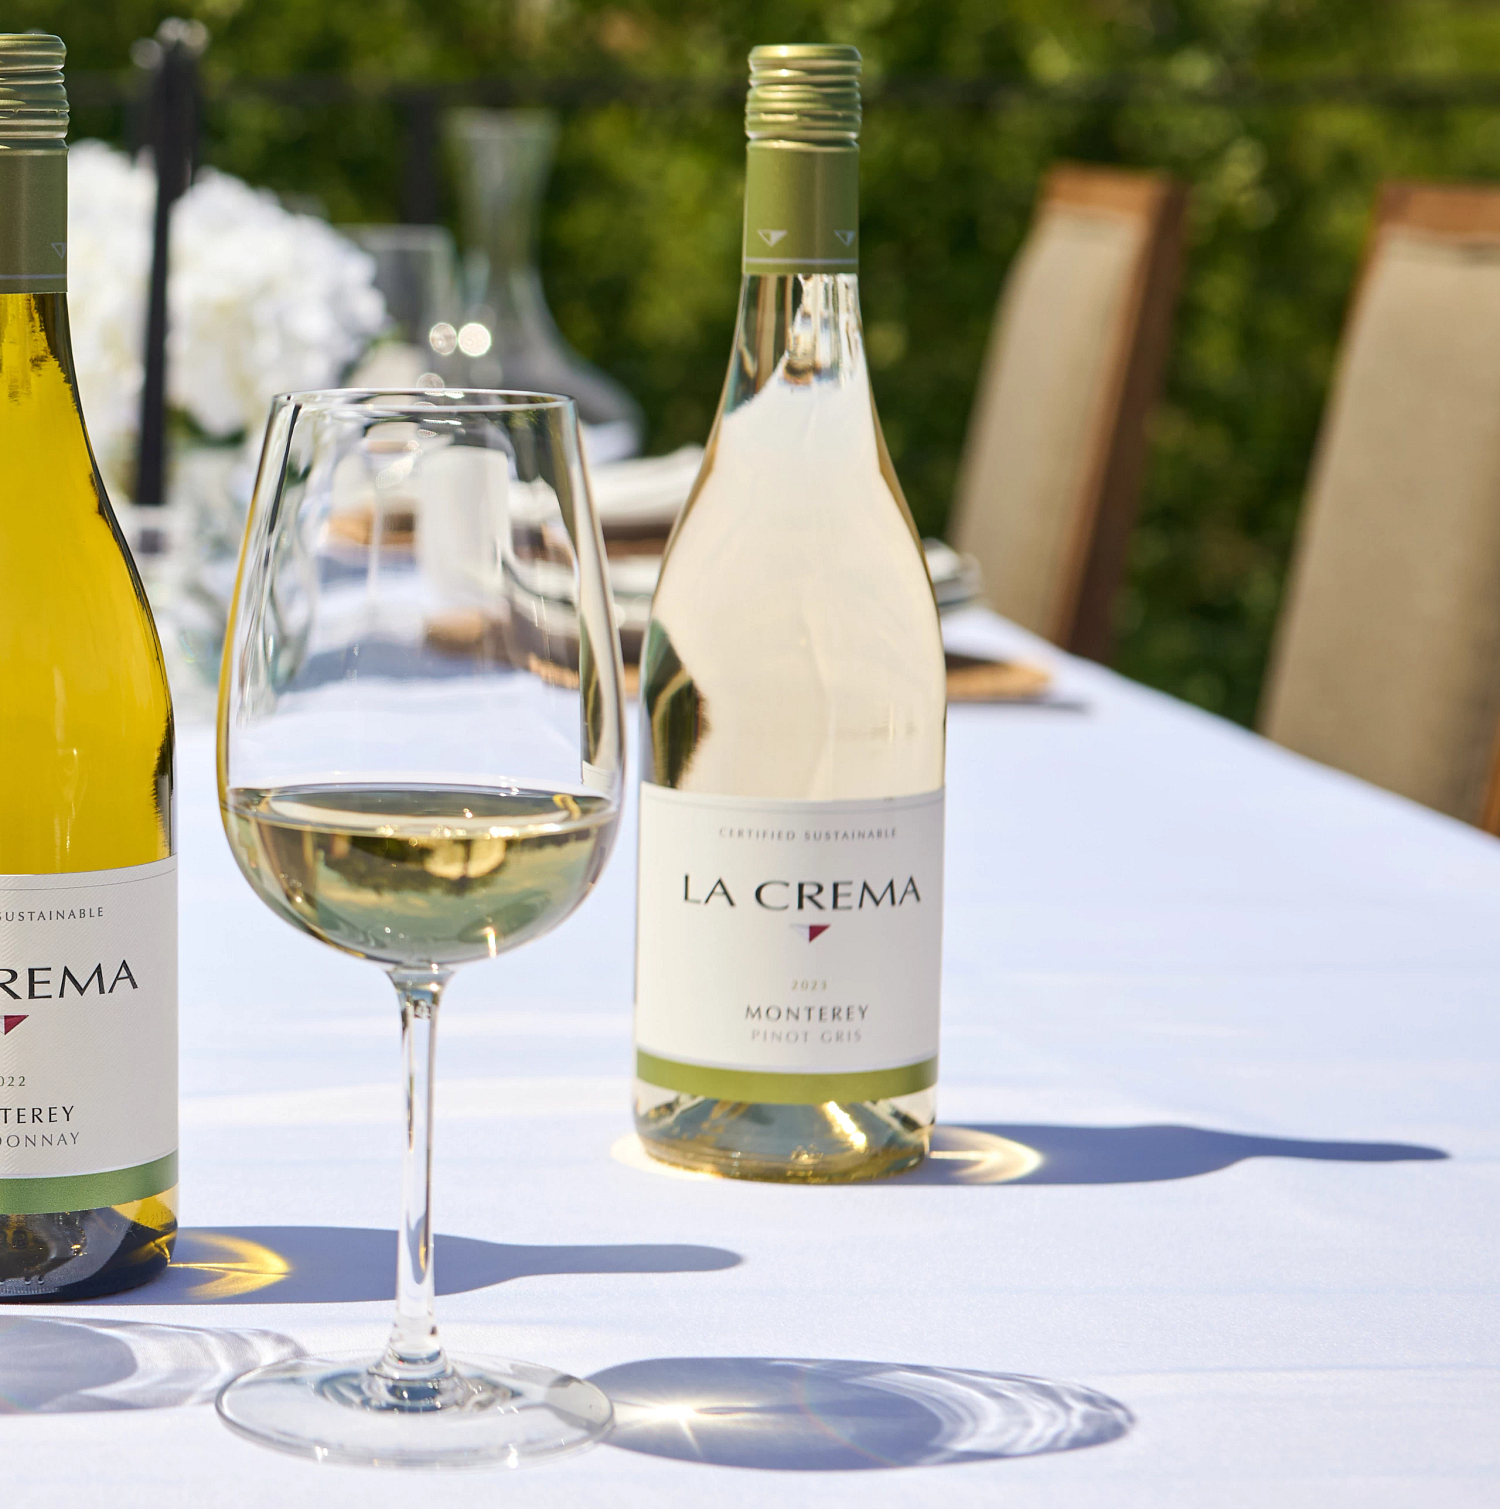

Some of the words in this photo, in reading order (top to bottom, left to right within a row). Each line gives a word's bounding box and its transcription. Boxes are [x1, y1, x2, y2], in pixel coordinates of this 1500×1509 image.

[718, 827, 796, 842] CERTIFIED
[803, 827, 898, 842] SUSTAINABLE
[683, 873, 736, 908] LA
[754, 875, 921, 911] CREMA
[791, 979, 828, 992] 2023
[745, 1004, 869, 1023] MONTEREY
[750, 1028, 811, 1044] PINOT
[819, 1028, 863, 1044] GRIS
